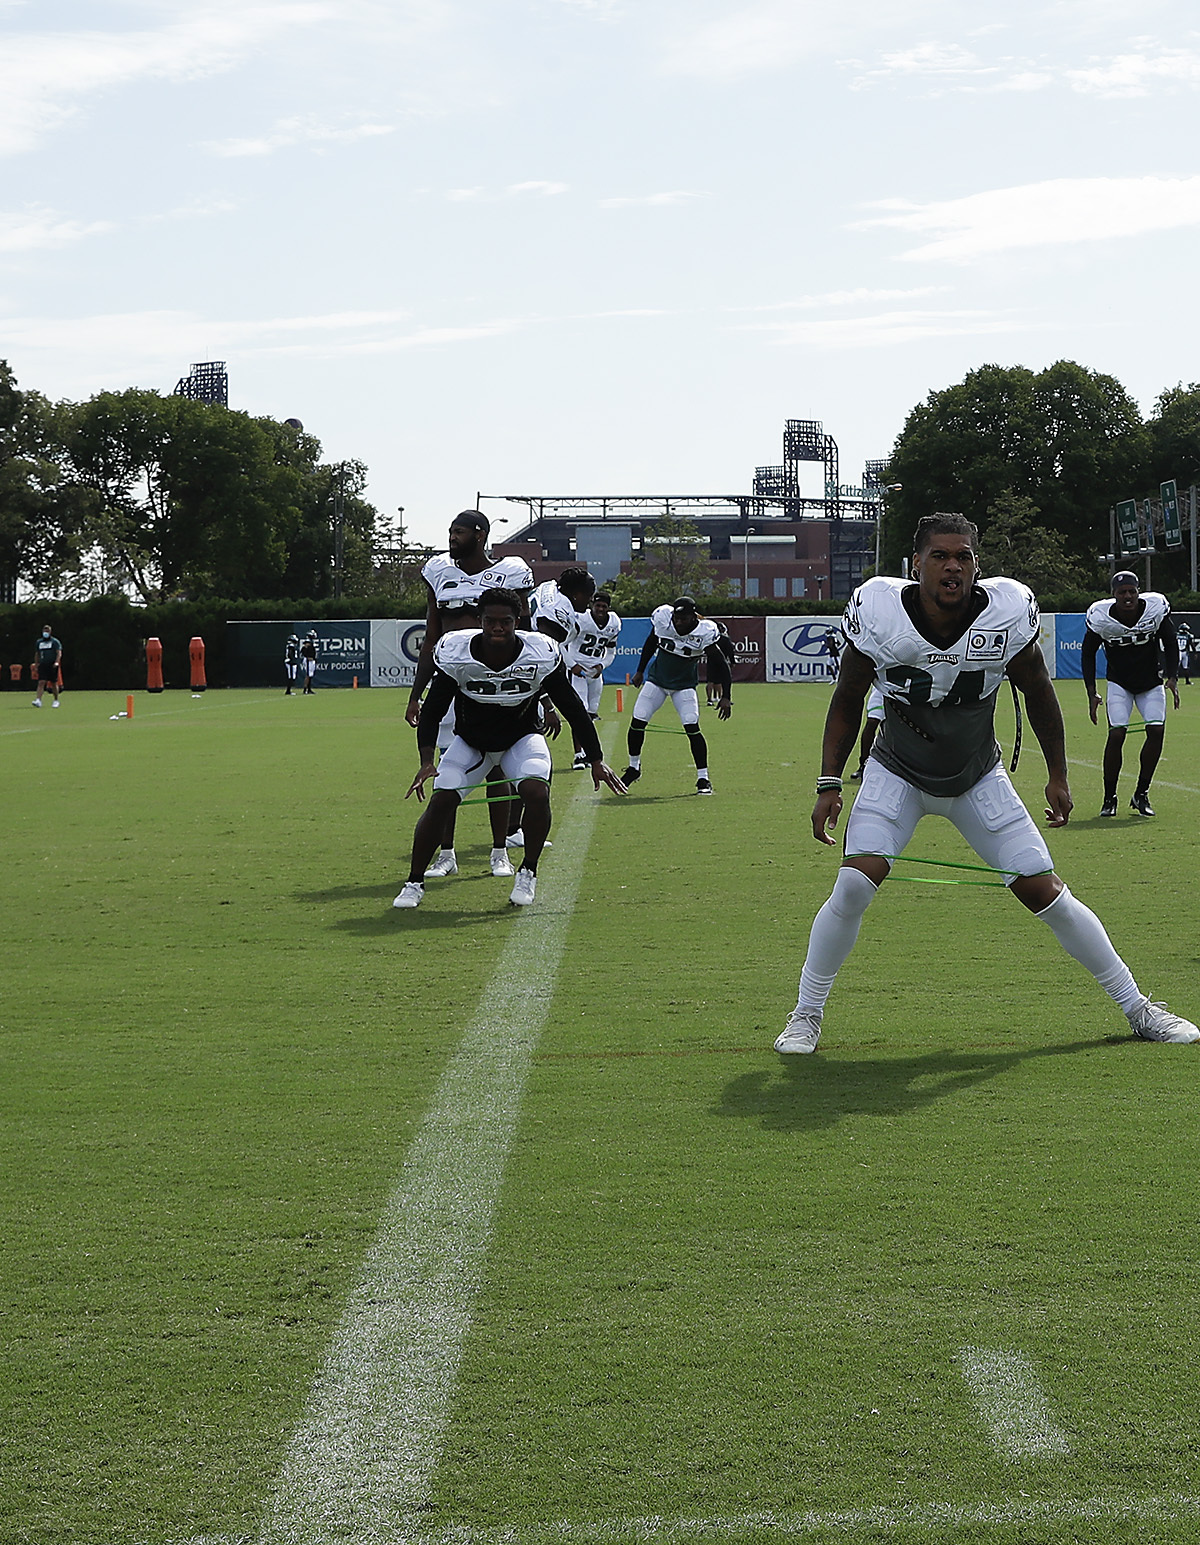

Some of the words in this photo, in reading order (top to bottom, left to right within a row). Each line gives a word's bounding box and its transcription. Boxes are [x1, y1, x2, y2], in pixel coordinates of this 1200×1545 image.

[731, 636, 760, 651] coln
[300, 663, 328, 671] WKLY
[331, 662, 365, 670] PODCAST
